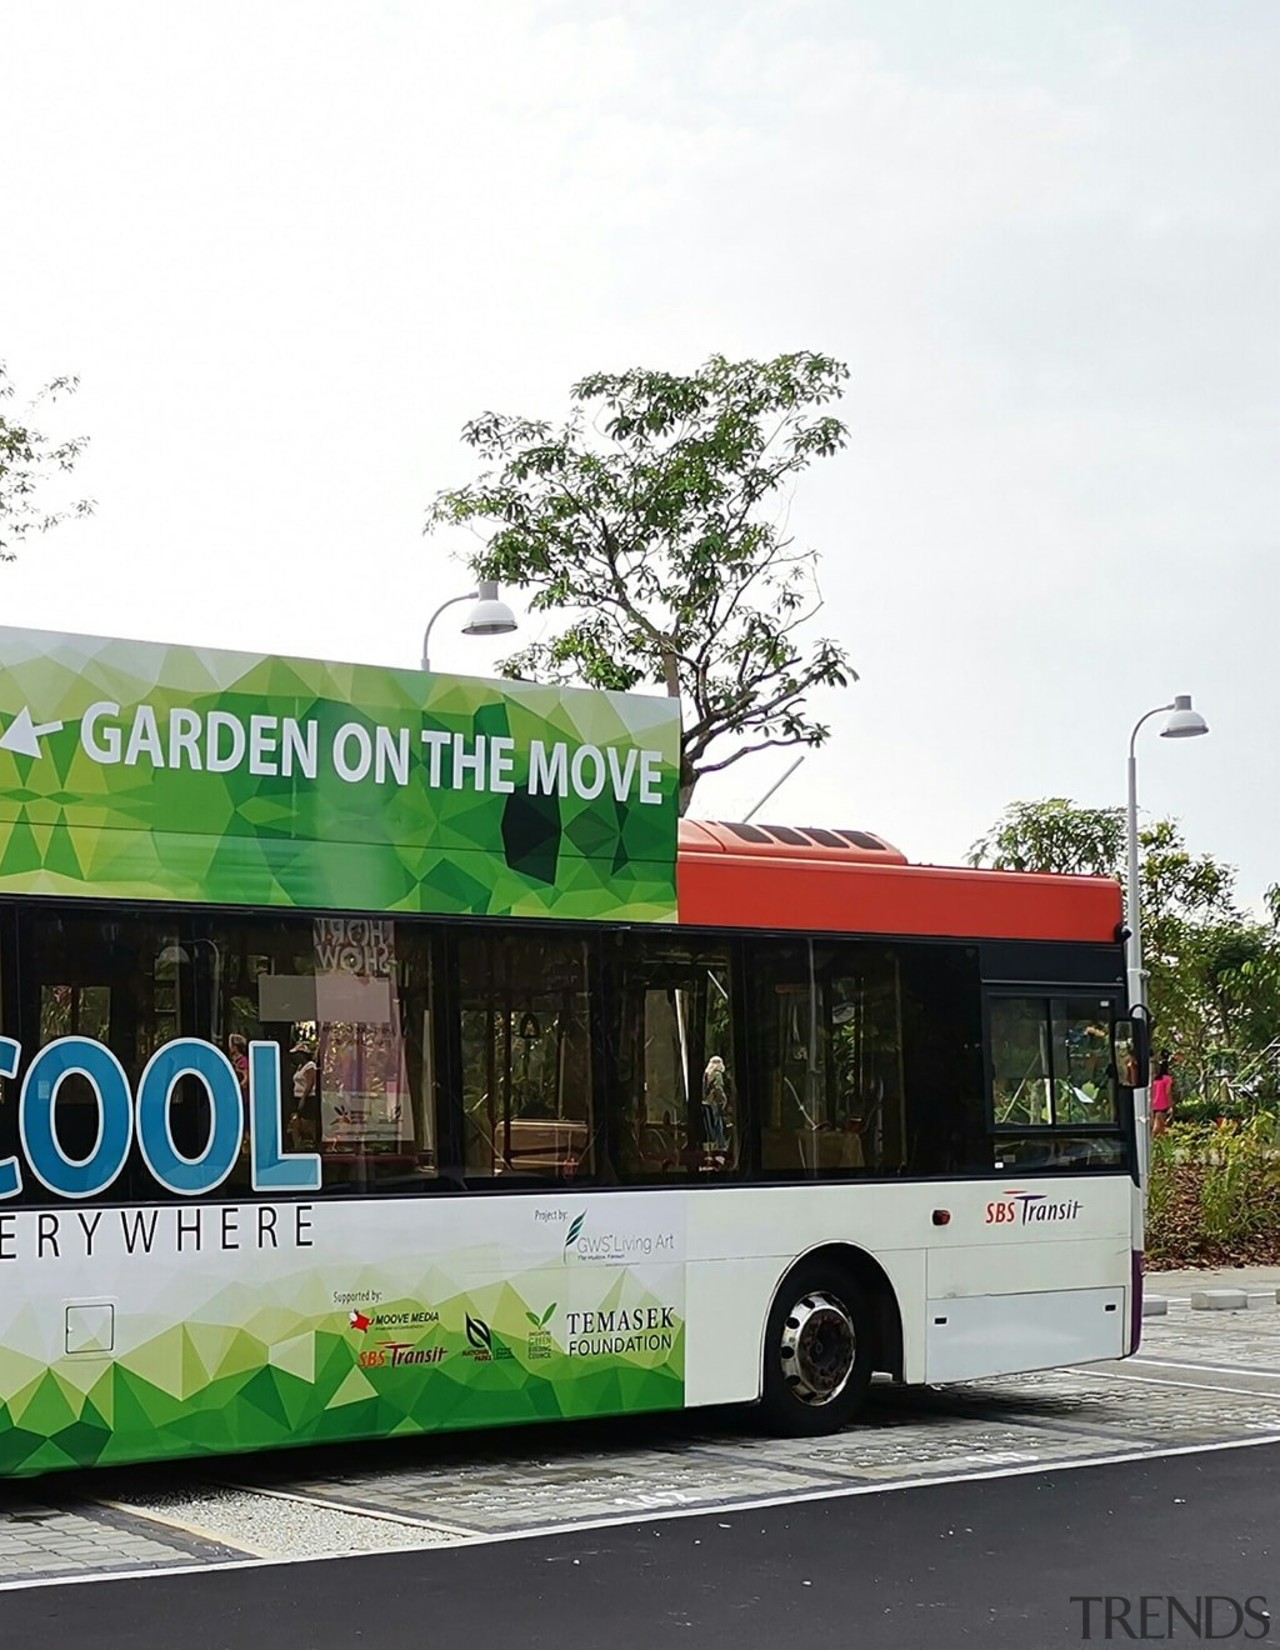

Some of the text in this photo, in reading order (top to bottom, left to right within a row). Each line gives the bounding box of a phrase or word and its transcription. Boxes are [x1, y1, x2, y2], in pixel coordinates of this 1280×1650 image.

[80, 702, 664, 805] GARDEN ON THE MOVE
[534, 1209, 557, 1222] Project
[985, 1195, 1083, 1225] SBS Transit
[614, 1235, 652, 1254] Living
[655, 1233, 675, 1249] Art
[333, 1289, 370, 1304] Supported
[376, 1312, 439, 1325] MOOVE MEDIA
[566, 1306, 675, 1335] TEMASEK
[360, 1344, 448, 1369] SBS Transit
[569, 1334, 671, 1357] FOUNDATION
